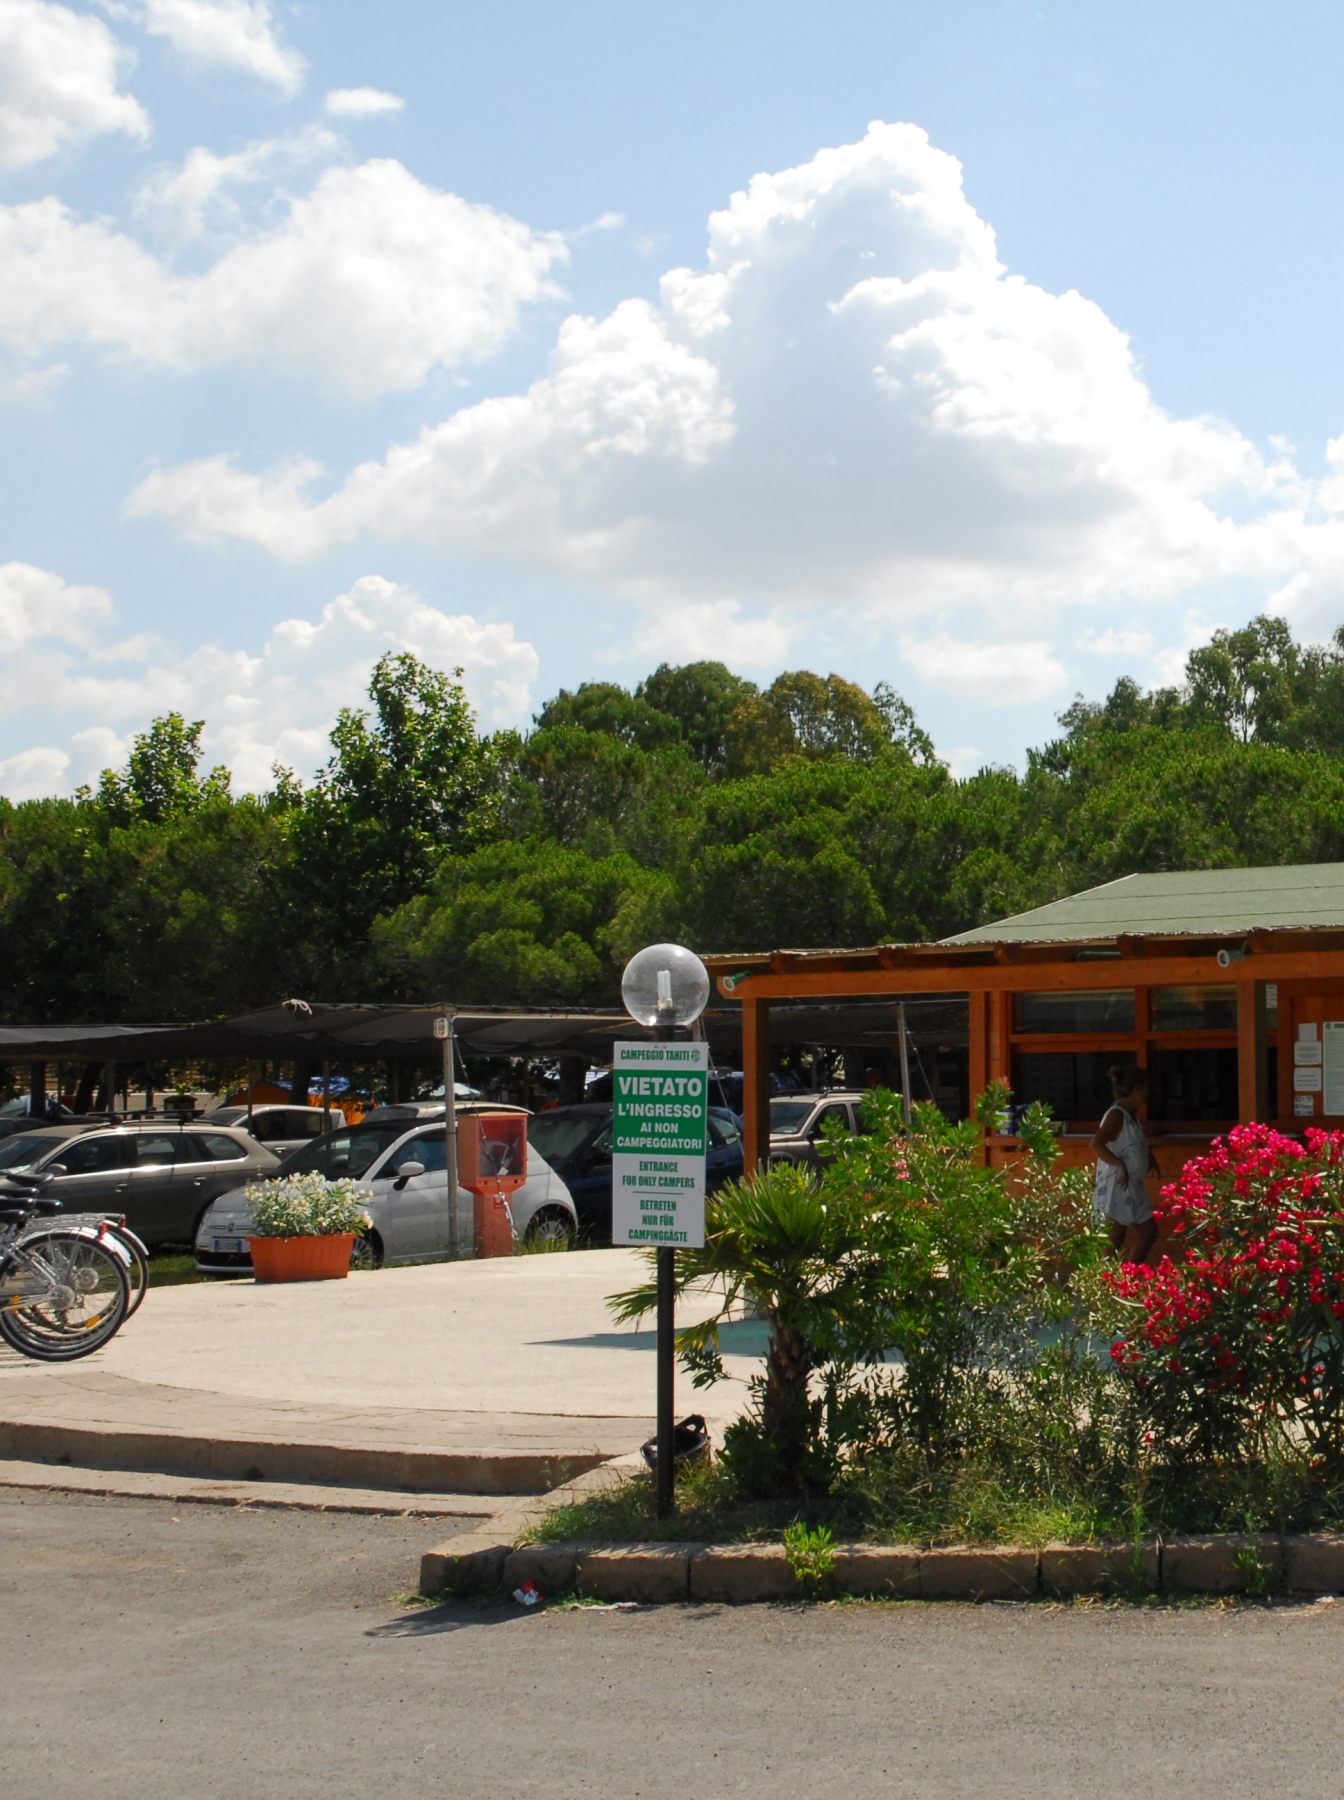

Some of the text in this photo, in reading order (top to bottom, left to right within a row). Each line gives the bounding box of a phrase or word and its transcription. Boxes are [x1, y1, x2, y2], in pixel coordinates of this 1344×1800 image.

[620, 1049, 690, 1061] CAMPEGGIO TAHITI
[618, 1076, 702, 1097] VIETATO
[618, 1103, 702, 1119] L'INGRESSO
[640, 1122, 679, 1134] AI NON
[617, 1136, 702, 1150] CAMPEGGIATORI
[639, 1161, 678, 1173] ENTRANCE
[622, 1175, 695, 1188] FOR ONLY CAMPERS
[640, 1199, 677, 1212] BETRETEN
[642, 1213, 674, 1226] NUR FÜR
[628, 1228, 688, 1242] CAMPINGGÄSTE
